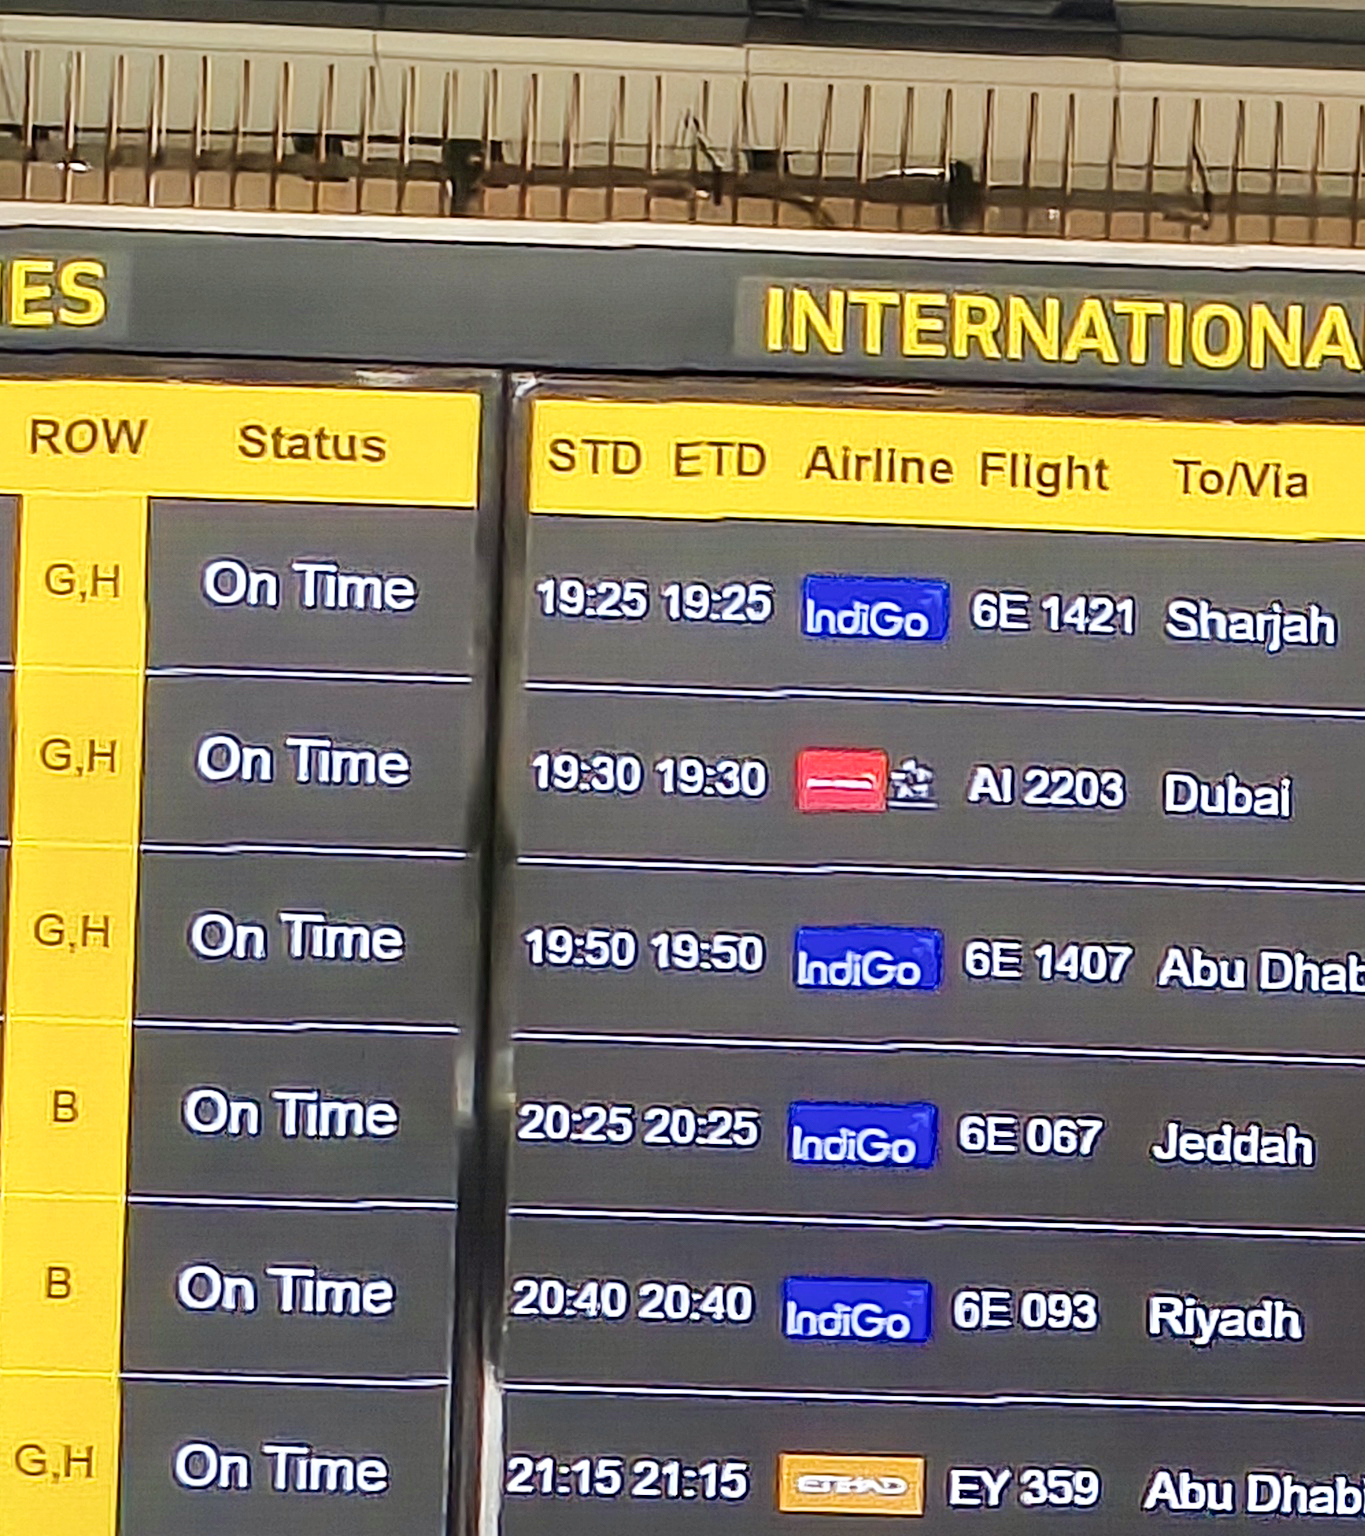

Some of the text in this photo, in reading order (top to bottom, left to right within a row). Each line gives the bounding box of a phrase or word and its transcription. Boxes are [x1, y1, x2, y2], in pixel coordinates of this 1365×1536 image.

[0, 260, 106, 326] ES
[30, 418, 386, 463] ROW Status
[548, 438, 642, 475] STD
[674, 440, 767, 478] ETD
[804, 445, 954, 485] Airline
[980, 451, 1110, 498] Flight
[1172, 458, 1308, 499] To/Via
[44, 560, 415, 610] G,H On Time
[537, 579, 648, 617] 19:25
[661, 583, 773, 621] 19:25
[806, 597, 929, 639] IndiGo
[973, 593, 1029, 629] 6E
[1041, 595, 1133, 634] 1421
[1165, 600, 1335, 652] Sharjah
[39, 738, 117, 777] G,H
[531, 753, 641, 792] 19:30
[655, 758, 766, 796] 19:30
[967, 767, 1012, 803] AI
[1023, 769, 1124, 807] 2203
[1165, 774, 1291, 817] Dubai
[33, 912, 403, 960] G,H On Time
[525, 928, 636, 967] 19:50
[650, 933, 763, 971] 19:50
[797, 950, 921, 987] IndiGo
[966, 941, 1022, 977] 6E
[1034, 944, 1133, 981] 1407
[1158, 948, 1245, 988] Abu
[52, 1089, 79, 1123] B
[517, 1103, 633, 1142] 20:25
[643, 1108, 759, 1146] 20:25
[792, 1125, 916, 1164] IndiGo
[959, 1115, 1018, 1152] 6E
[1026, 1118, 1103, 1155] 067
[1152, 1122, 1313, 1165] Jeddah
[46, 1265, 393, 1314] B On Time
[510, 1279, 627, 1318] 20:40
[638, 1283, 752, 1321] 20:40
[786, 1300, 911, 1339] IndiGo
[954, 1290, 1012, 1329] 6E
[1021, 1292, 1097, 1329] 093
[1149, 1296, 1302, 1345] Riyadh
[14, 1443, 94, 1481] G,H
[506, 1454, 623, 1495] 21:15
[631, 1460, 748, 1499] 21:15
[949, 1469, 1012, 1506] EY
[1019, 1469, 1099, 1506] 359
[1143, 1471, 1233, 1511] Abu
